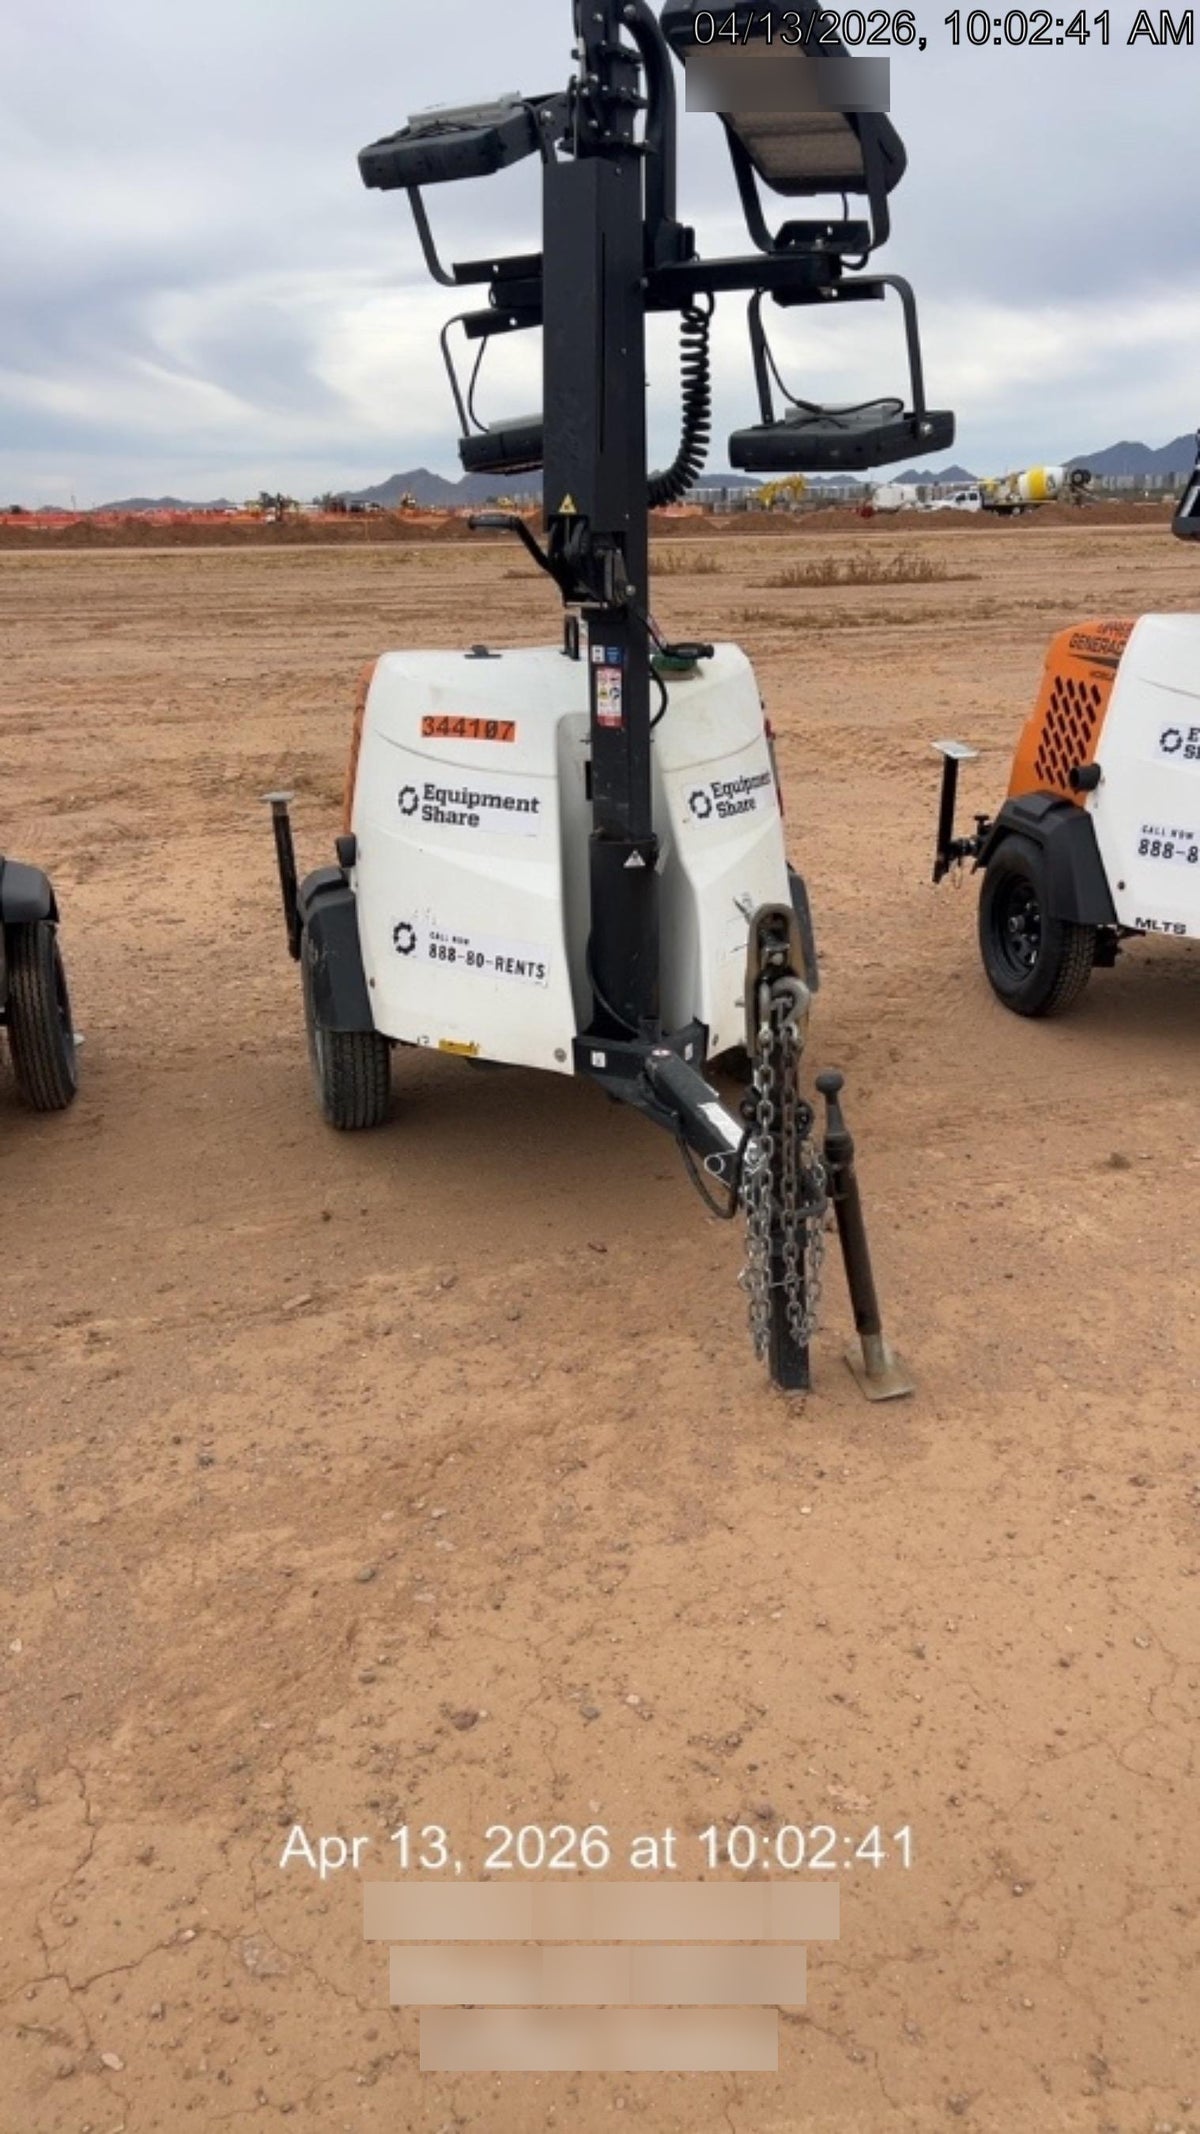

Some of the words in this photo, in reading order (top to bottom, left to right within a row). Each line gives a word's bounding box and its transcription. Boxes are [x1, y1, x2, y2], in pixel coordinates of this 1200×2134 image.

[422, 716, 515, 741] 344107
[422, 782, 541, 814] Equipment
[421, 804, 480, 827] Share
[1138, 838, 1200, 864] 888-8
[428, 943, 546, 980] 888-80-RENTS
